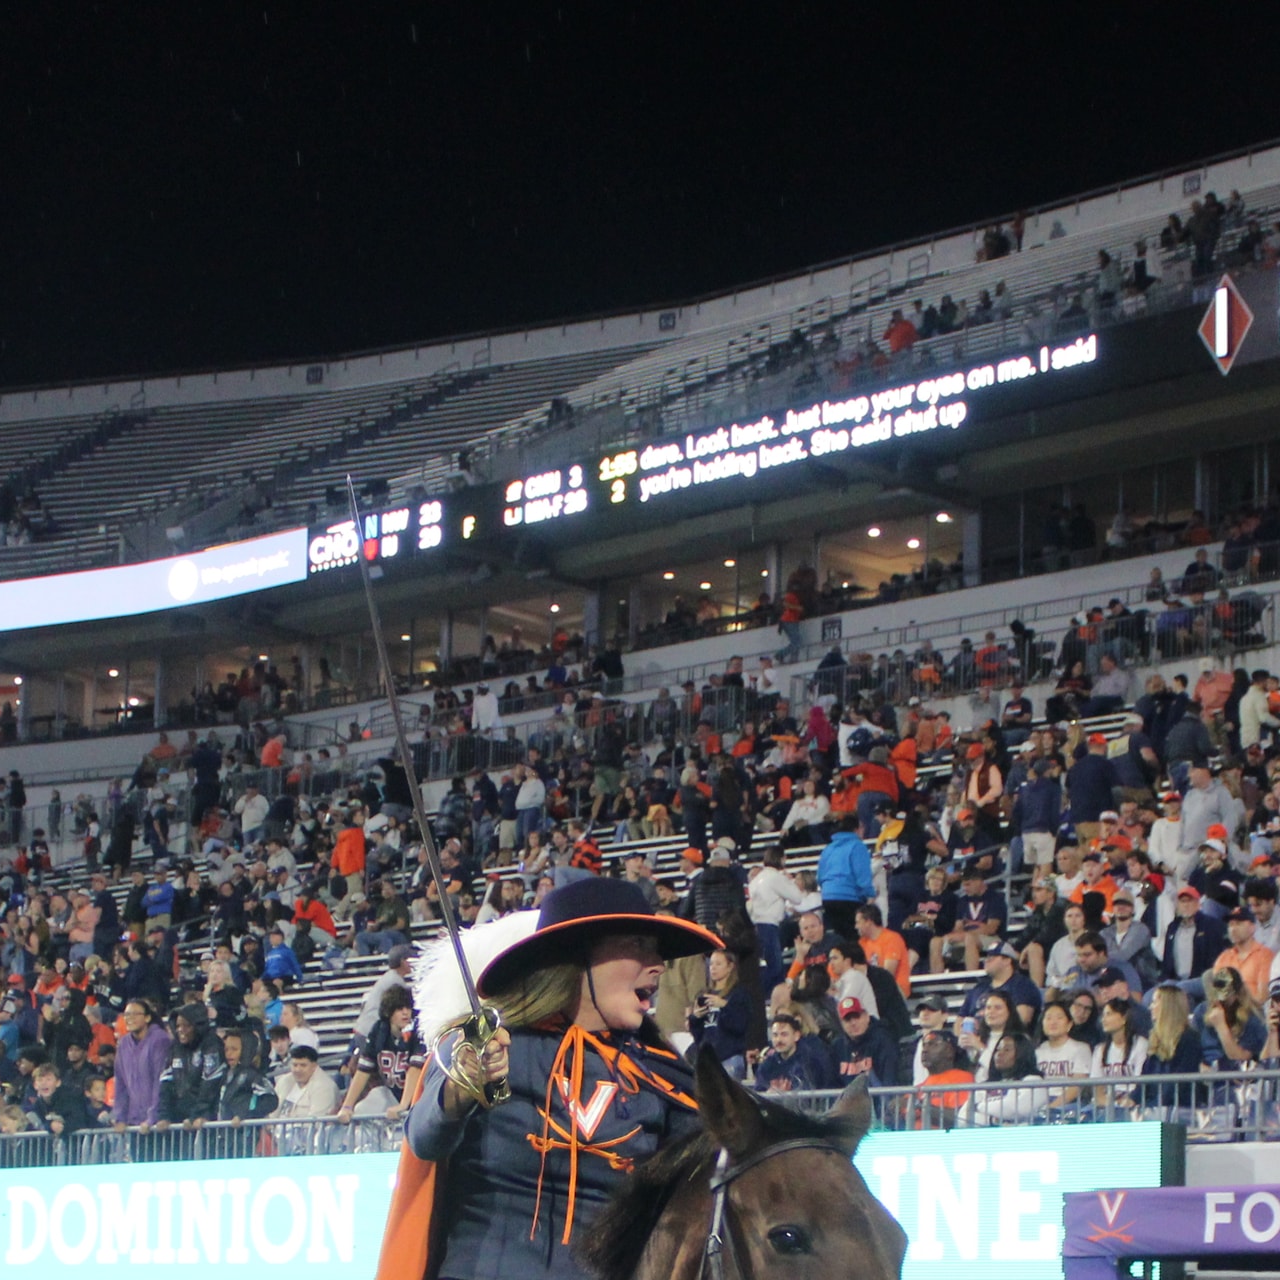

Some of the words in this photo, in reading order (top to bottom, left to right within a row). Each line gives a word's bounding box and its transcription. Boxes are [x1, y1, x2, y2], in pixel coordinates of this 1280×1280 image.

[1215, 287, 1230, 358] 1
[686, 427, 729, 459] Look
[781, 404, 821, 435] Just
[822, 396, 870, 424] keep
[871, 384, 915, 418] your
[917, 372, 965, 404] eyes
[967, 365, 995, 390] on
[997, 356, 1037, 384] me.
[1040, 346, 1049, 373] I
[1051, 334, 1098, 371] said
[694, 450, 756, 485] holding
[810, 429, 849, 456] She
[851, 414, 891, 447] said
[893, 404, 938, 437] shut
[939, 401, 967, 429] up
[462, 515, 476, 539] F
[610, 479, 626, 503] 2
[5, 1173, 360, 1266] DOMINION
[872, 1150, 1059, 1261] INE
